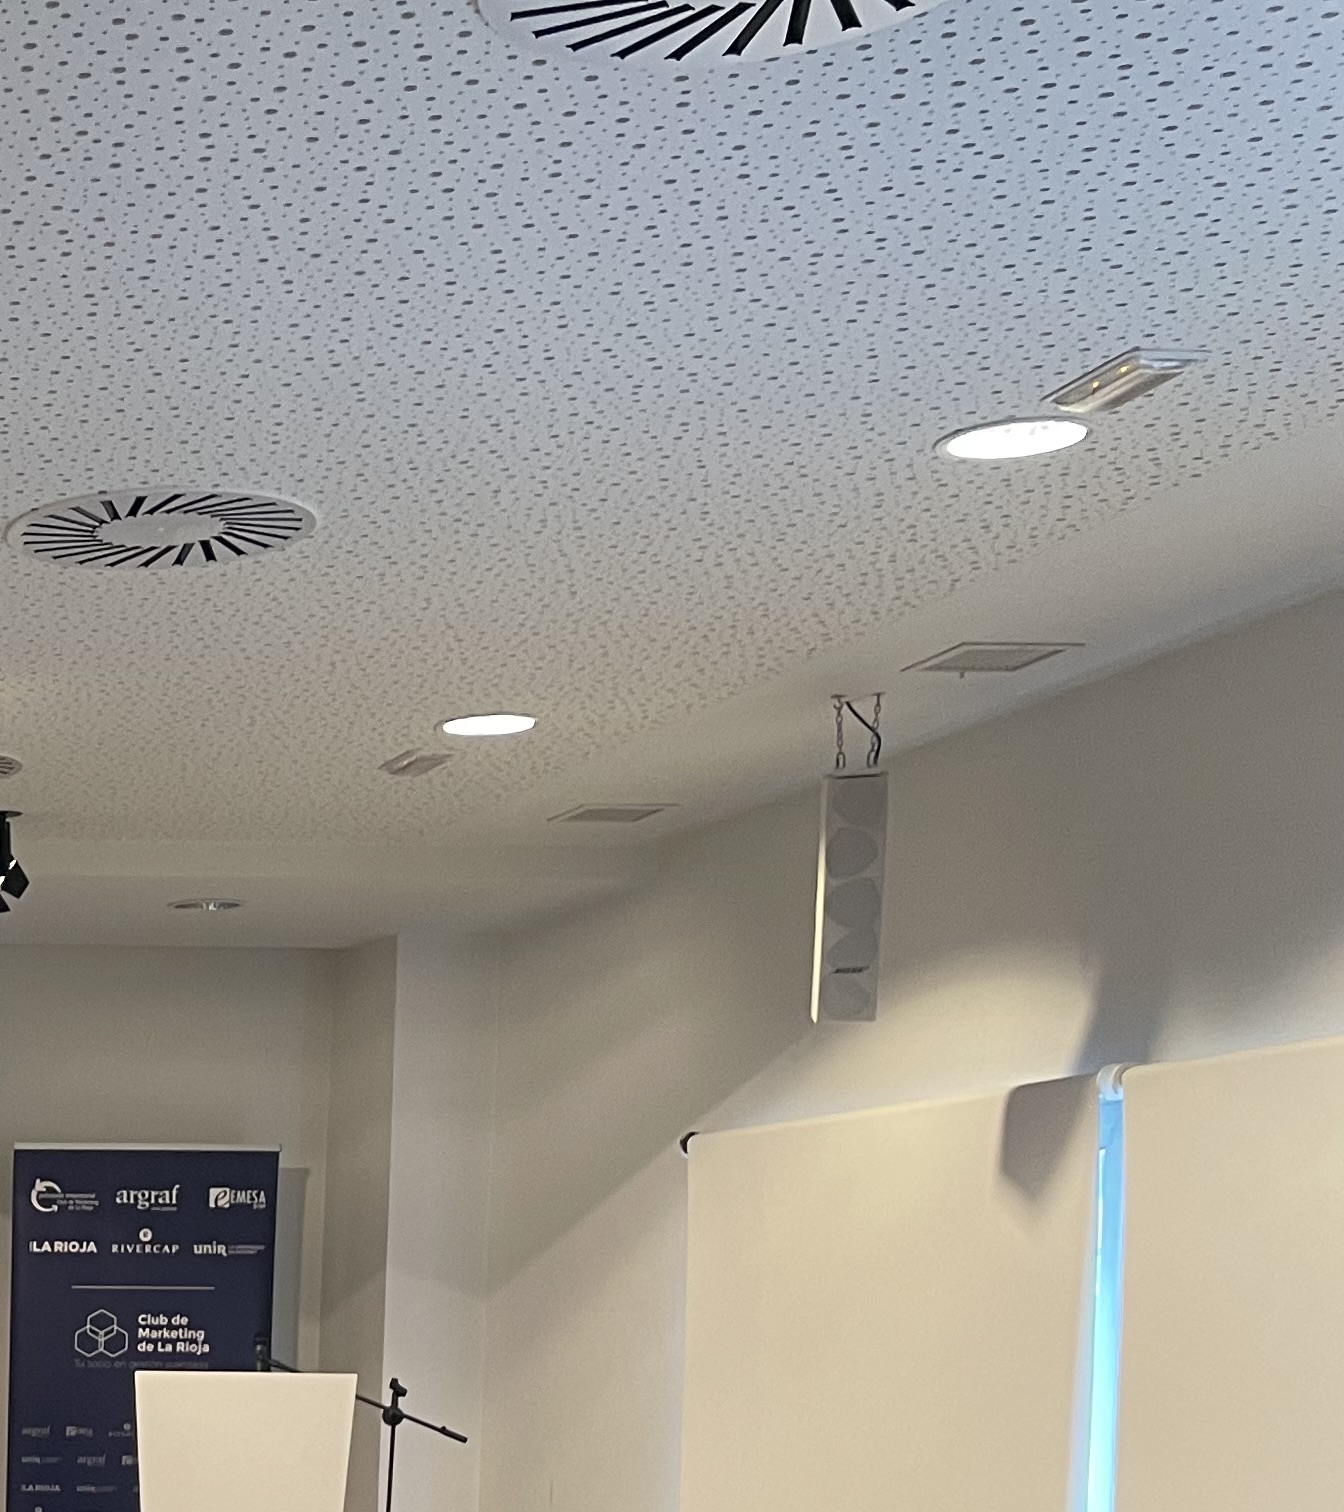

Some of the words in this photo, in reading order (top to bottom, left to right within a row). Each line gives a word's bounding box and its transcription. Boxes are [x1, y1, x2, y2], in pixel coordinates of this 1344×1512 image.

[115, 1184, 180, 1210] argraf
[230, 1190, 266, 1204] EMESA
[32, 1241, 52, 1252] LA
[53, 1241, 98, 1253] RIOJA
[111, 1244, 180, 1254] RIVERCAP
[138, 1313, 169, 1326] Club
[171, 1313, 189, 1326] de
[137, 1327, 205, 1341] Marketing
[137, 1340, 155, 1352] de
[157, 1341, 173, 1352] La
[176, 1340, 210, 1356] Rioja
